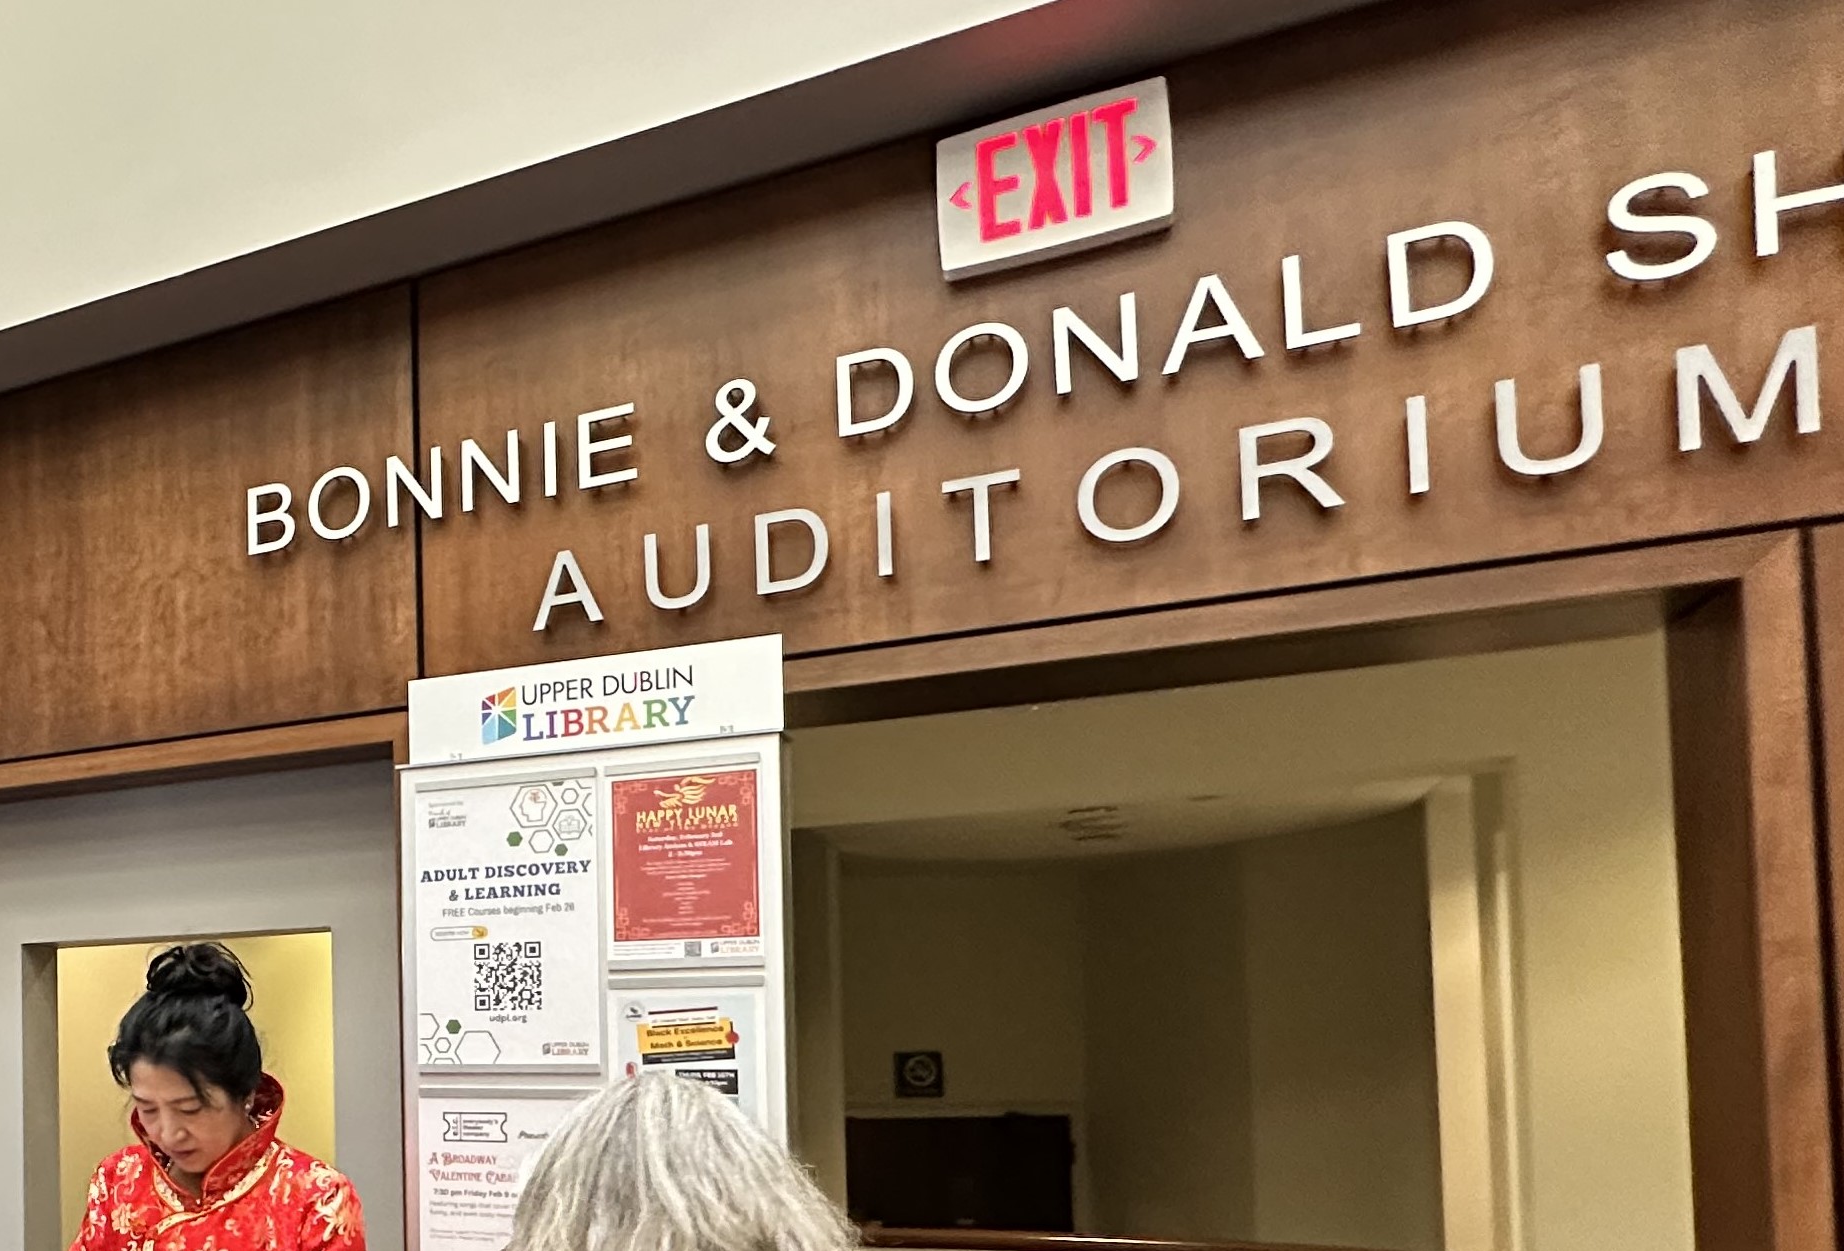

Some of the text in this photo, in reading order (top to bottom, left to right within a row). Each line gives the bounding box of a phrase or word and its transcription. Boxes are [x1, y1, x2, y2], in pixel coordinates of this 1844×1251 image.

[973, 96, 1140, 246] EXIT
[247, 402, 639, 557] BONNIE
[705, 377, 777, 465] &
[836, 219, 1495, 440] DONALD
[533, 325, 1823, 632] AUDITORIUM
[522, 665, 694, 706] UPPER DUBLIN
[522, 695, 696, 741] LIBRARY
[636, 804, 737, 823] HAPPY LUNAR
[420, 859, 592, 883] ADULT DISCOVERY
[449, 883, 561, 901] & LEARNING
[442, 907, 465, 917] FREE
[468, 905, 501, 916] Courses
[503, 903, 544, 916] beginning
[545, 902, 562, 912] Feb
[489, 1013, 527, 1024] udpl.org
[646, 1025, 724, 1037] Black Excellence
[650, 1041, 674, 1049] Math
[685, 1038, 723, 1047] Science
[427, 1152, 439, 1165] A
[464, 1189, 487, 1199] Friday
[489, 1190, 503, 1198] Feb
